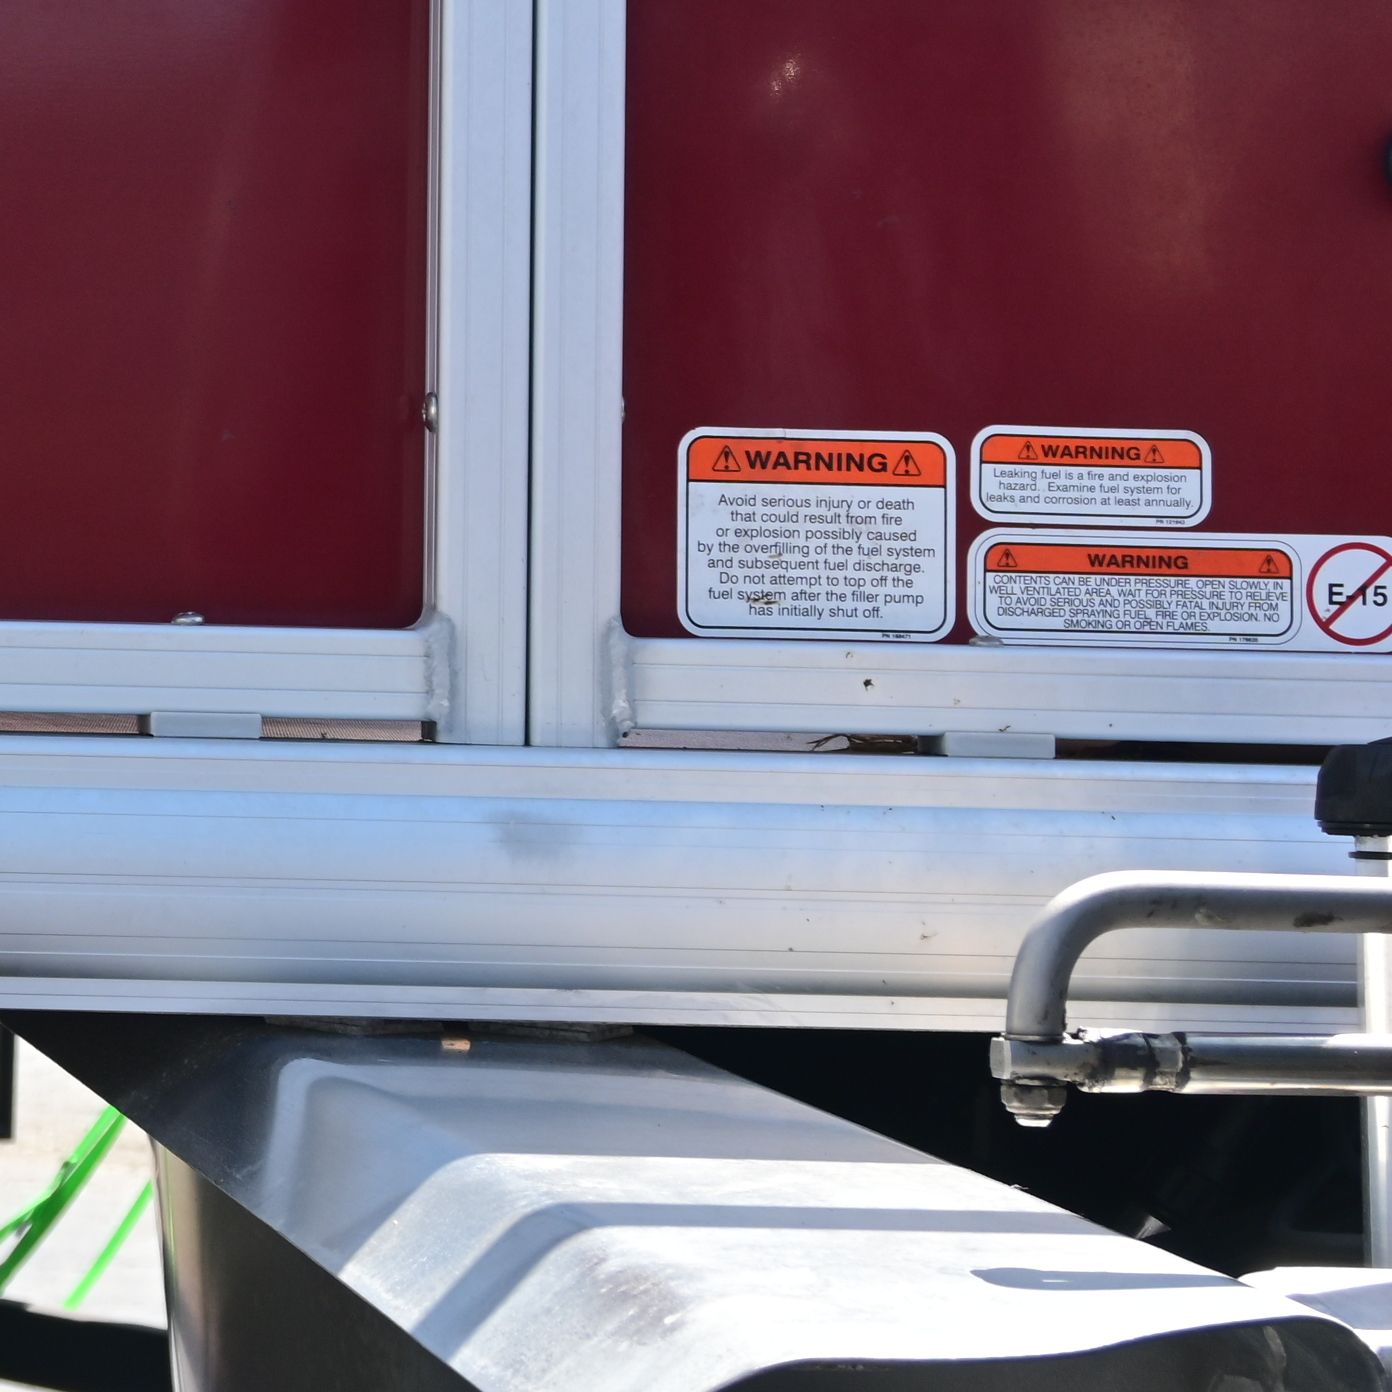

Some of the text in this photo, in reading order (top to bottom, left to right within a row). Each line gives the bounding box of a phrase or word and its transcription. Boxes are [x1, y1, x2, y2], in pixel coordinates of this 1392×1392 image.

[1041, 444, 1141, 461] WARNING
[745, 450, 888, 473] WARNING
[993, 468, 1186, 485] Leaking fuel is a fire and explosion
[998, 480, 1182, 496] hazard. Examine fuel system for
[717, 494, 914, 513] Avoid serious injury or death
[986, 493, 1193, 510] leaks and corrosion at least annually.
[730, 509, 902, 526] that could result from fire
[715, 526, 916, 545] or explosion possibly caused
[697, 540, 935, 560] by the overfilling of the fuel system
[707, 556, 924, 576] and subsequent fuel discharge.
[1087, 553, 1189, 570] WARNING
[719, 571, 913, 589] Do not attempt to top off the
[992, 574, 1283, 592] CONTENTS CAN BE UNDER PRESSURE, OPEN SLOWLY, IN
[707, 586, 924, 607] fuel system after the filler pump
[988, 585, 1288, 602] WELL VENTILATED AREA, WAIT FOR PRESSURE TO RELIEVE
[748, 604, 883, 620] has initially shut off.
[997, 595, 1278, 612] TO AVOID SERIOUS AND POSSIBLY FATAL INJURY FROM
[996, 606, 1280, 622] DISCHARGED SPRAYING FUEL, FIRE OR EXPLOSION. NO
[1063, 618, 1210, 632] SMOKING OR OPEN FLAMES.
